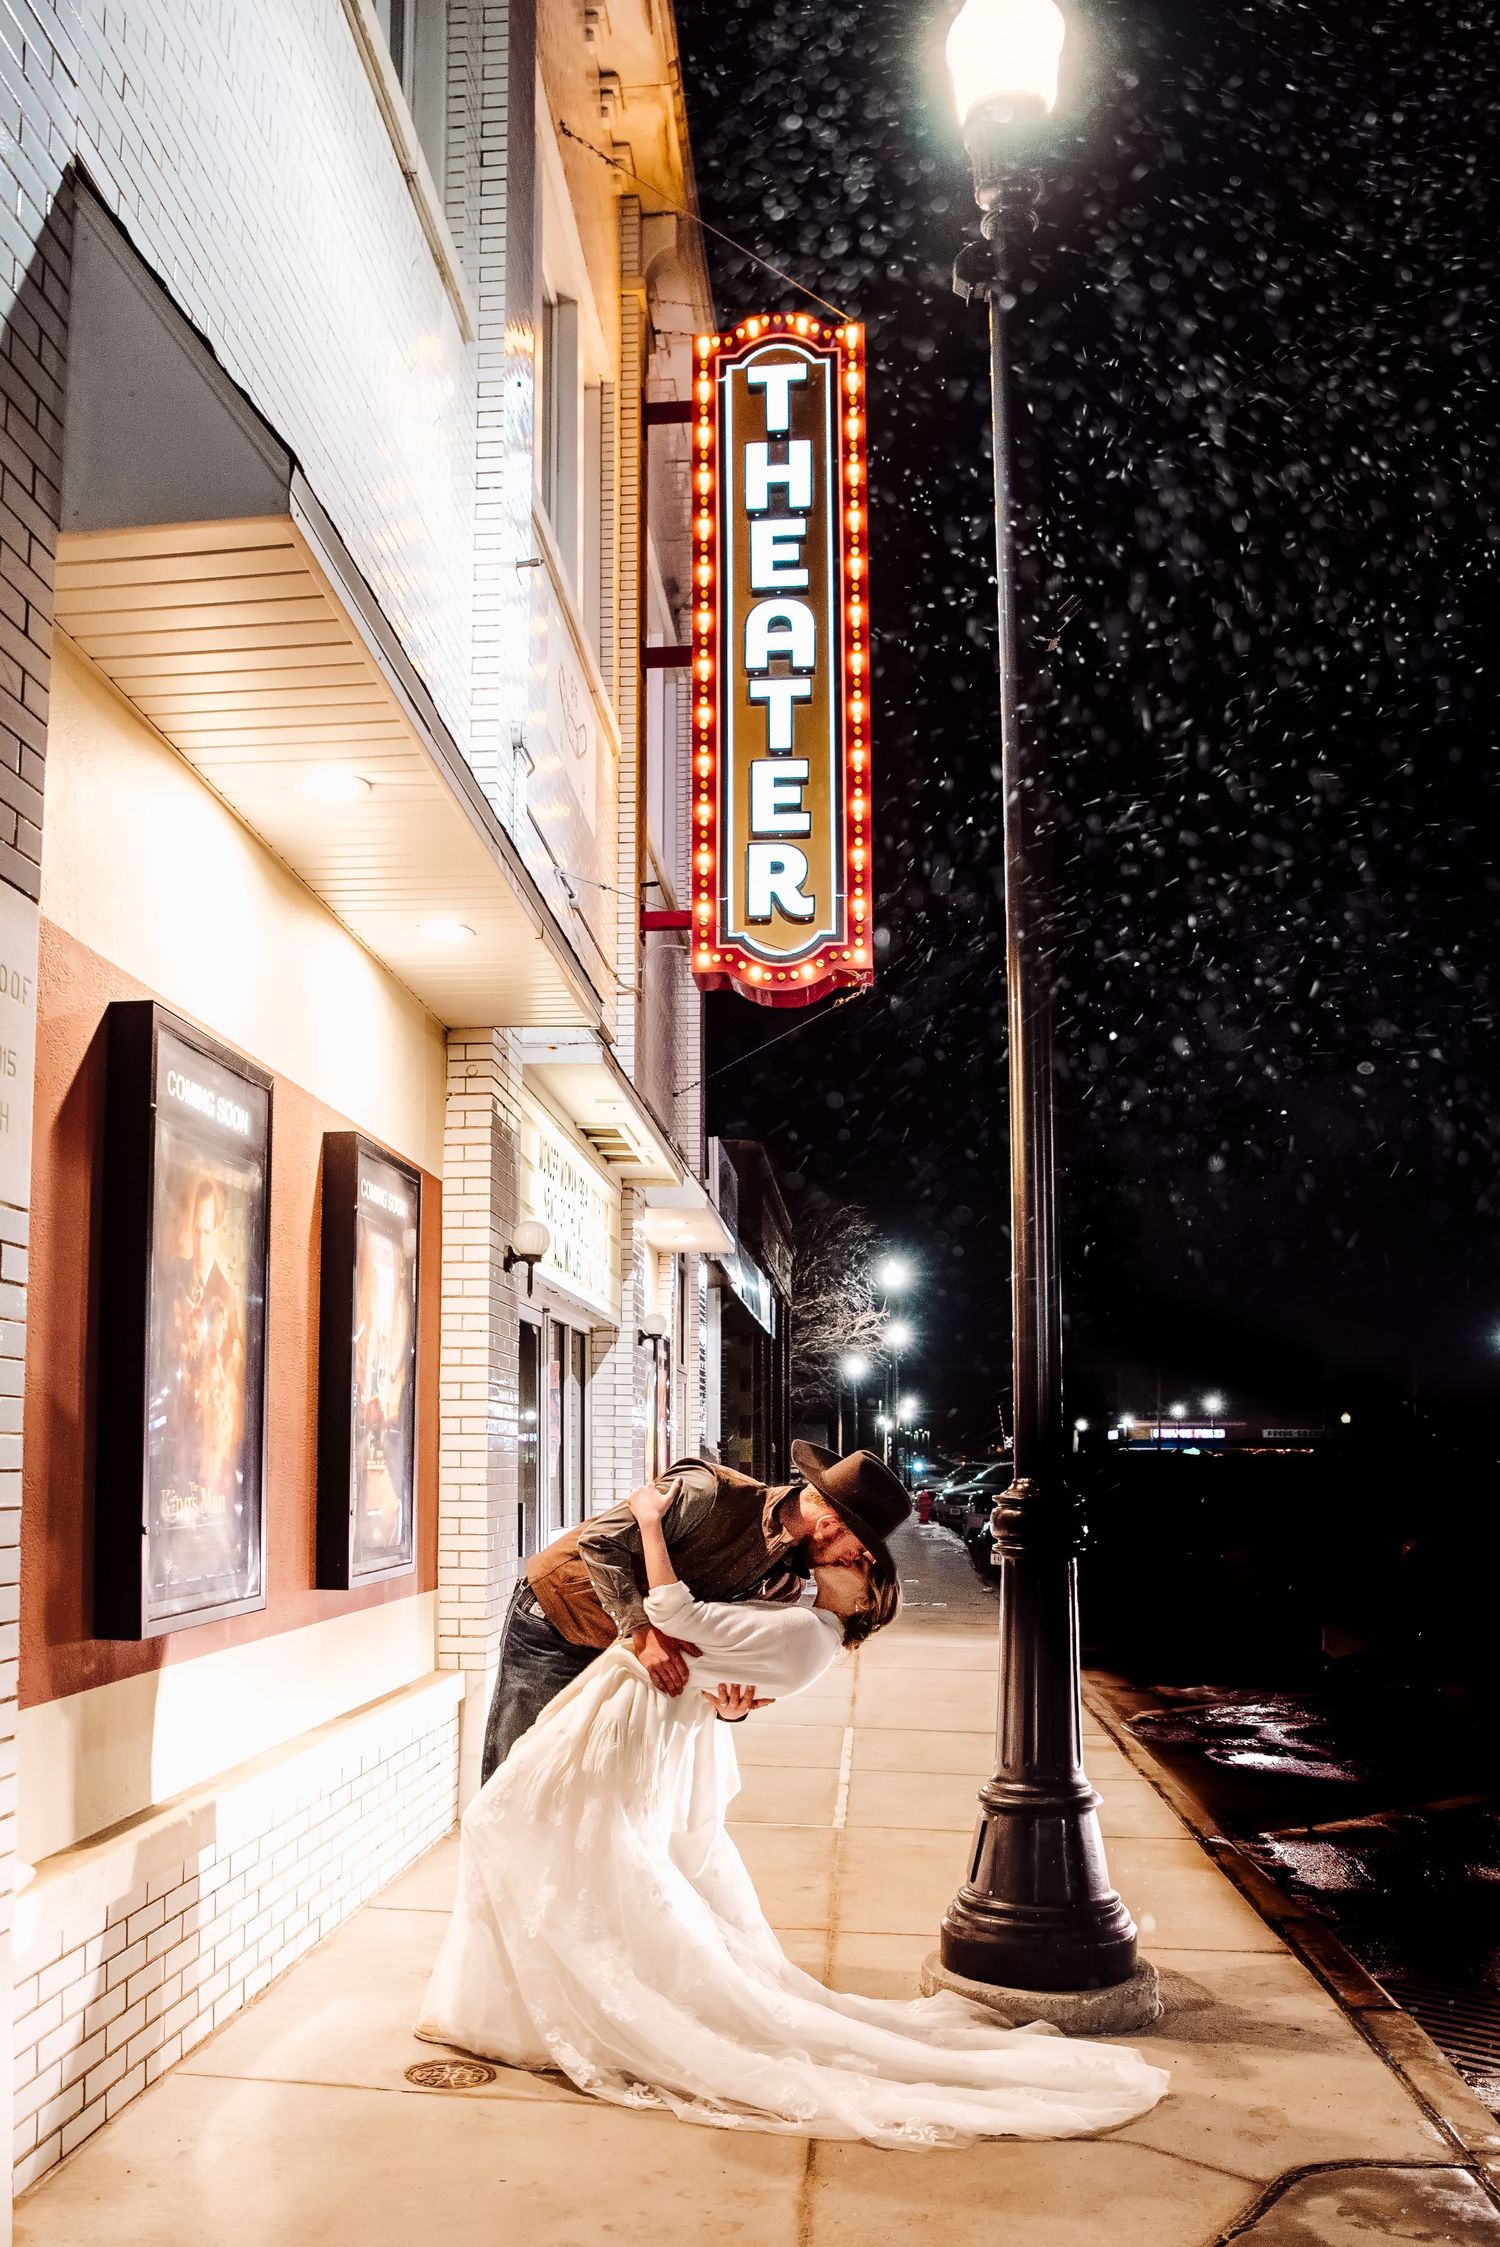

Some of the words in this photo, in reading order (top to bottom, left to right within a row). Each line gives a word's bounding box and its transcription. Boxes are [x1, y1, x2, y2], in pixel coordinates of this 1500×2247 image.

[744, 362, 817, 924] THEATER
[0, 1045, 17, 1078] 15
[167, 1070, 215, 1118] COMING
[216, 1097, 249, 1135] SOON
[361, 1178, 387, 1209] COMING
[388, 1193, 406, 1219] SOON
[200, 1487, 226, 1516] Man
